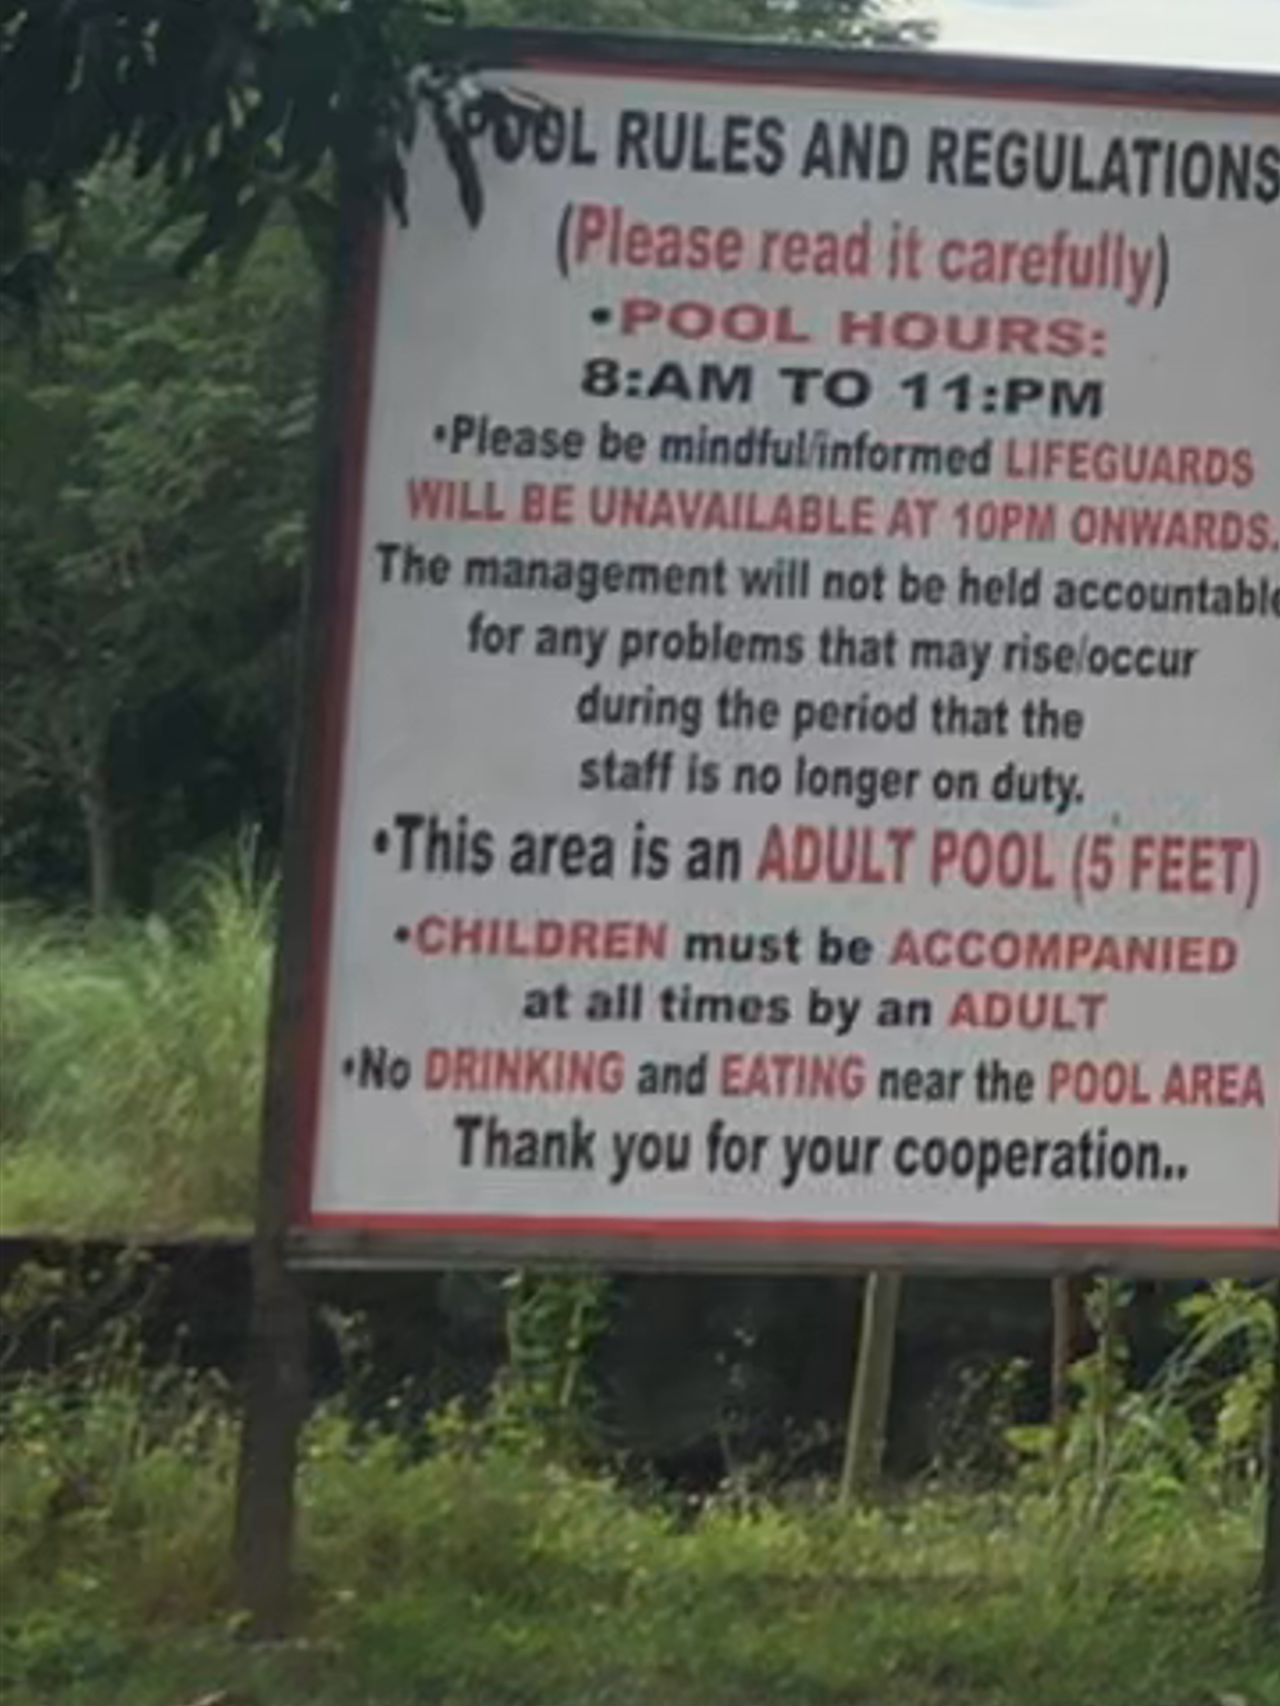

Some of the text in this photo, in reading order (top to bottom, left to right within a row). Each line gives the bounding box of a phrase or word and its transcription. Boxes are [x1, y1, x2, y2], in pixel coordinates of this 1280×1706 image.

[616, 109, 786, 177] RULES
[800, 119, 910, 183] AND
[555, 201, 1170, 310] (Please read it carefully)
[838, 309, 1106, 359] HOURS:
[580, 357, 1104, 419] 8:AM TO 11:PM
[598, 420, 647, 464] be
[1004, 437, 1255, 489] LIFEGUARDS
[406, 477, 1280, 554] WILL BE UNAVAILABLE AT 10PM ONWARDS.
[374, 541, 452, 587] The
[463, 556, 728, 604] management
[738, 557, 811, 599] will
[822, 565, 887, 604] not
[898, 562, 947, 606] be
[958, 565, 1042, 609] held
[467, 610, 525, 656] for
[535, 624, 609, 670] any
[618, 619, 805, 670] problems
[818, 625, 898, 669] that
[909, 638, 993, 682] may
[575, 682, 1085, 742] during the period that the
[579, 749, 1084, 816] staff is no longer on duty.
[509, 831, 615, 878] area
[631, 819, 670, 881] is
[685, 836, 742, 882] an
[755, 823, 917, 885] ADULT
[929, 828, 1056, 890] POOL
[1129, 834, 1260, 910] FEET)
[684, 927, 801, 966] must
[817, 926, 874, 966] be
[887, 928, 1238, 974] ACCOMPANIED
[522, 982, 1108, 1037] at all times by an ADULT
[424, 1046, 625, 1095] DRINKING
[636, 1052, 708, 1097] and
[719, 1052, 866, 1101] EATING
[878, 1067, 965, 1103] near
[974, 1058, 1035, 1104] the
[1046, 1059, 1151, 1106] POOL
[1161, 1061, 1265, 1108] AREA
[453, 1114, 597, 1170] Thank
[609, 1131, 691, 1186] you
[706, 1118, 770, 1174] for
[780, 1135, 882, 1189] your
